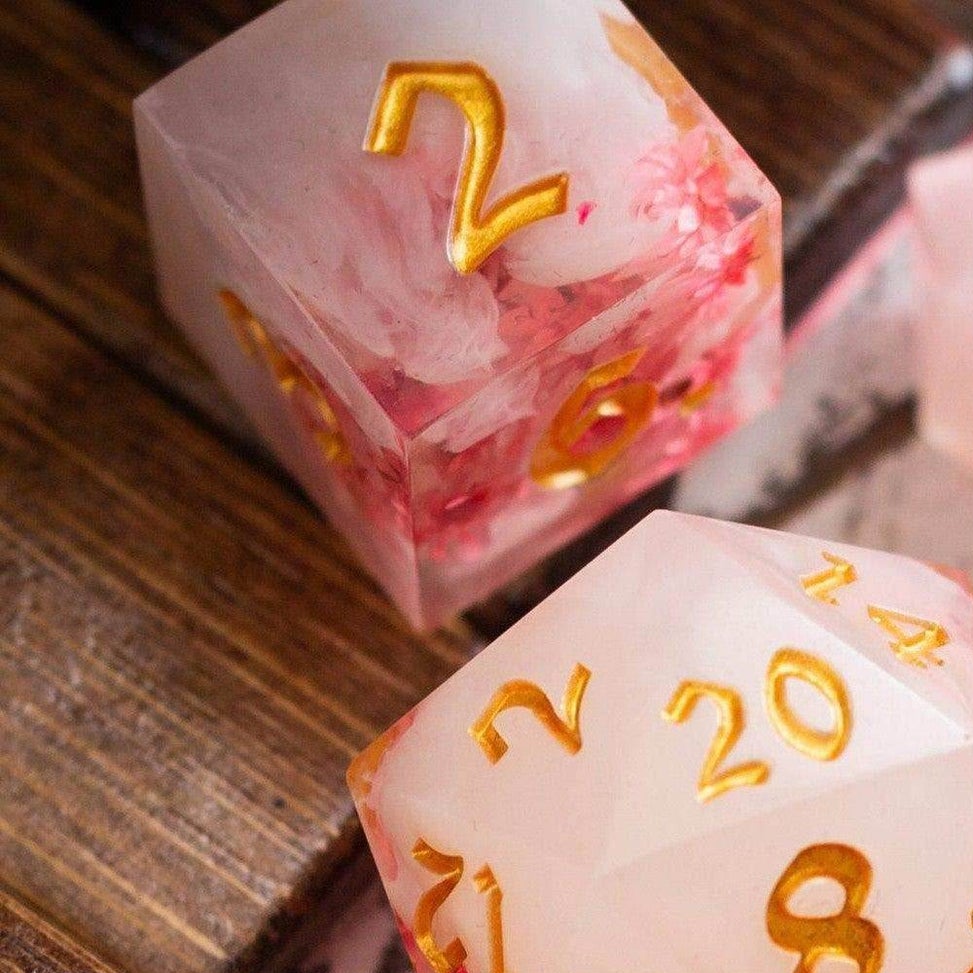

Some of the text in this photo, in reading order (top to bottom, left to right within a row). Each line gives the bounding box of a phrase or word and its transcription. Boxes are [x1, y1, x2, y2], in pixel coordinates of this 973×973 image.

[363, 60, 571, 275] 2
[468, 663, 591, 764] 2
[662, 647, 852, 801] 20
